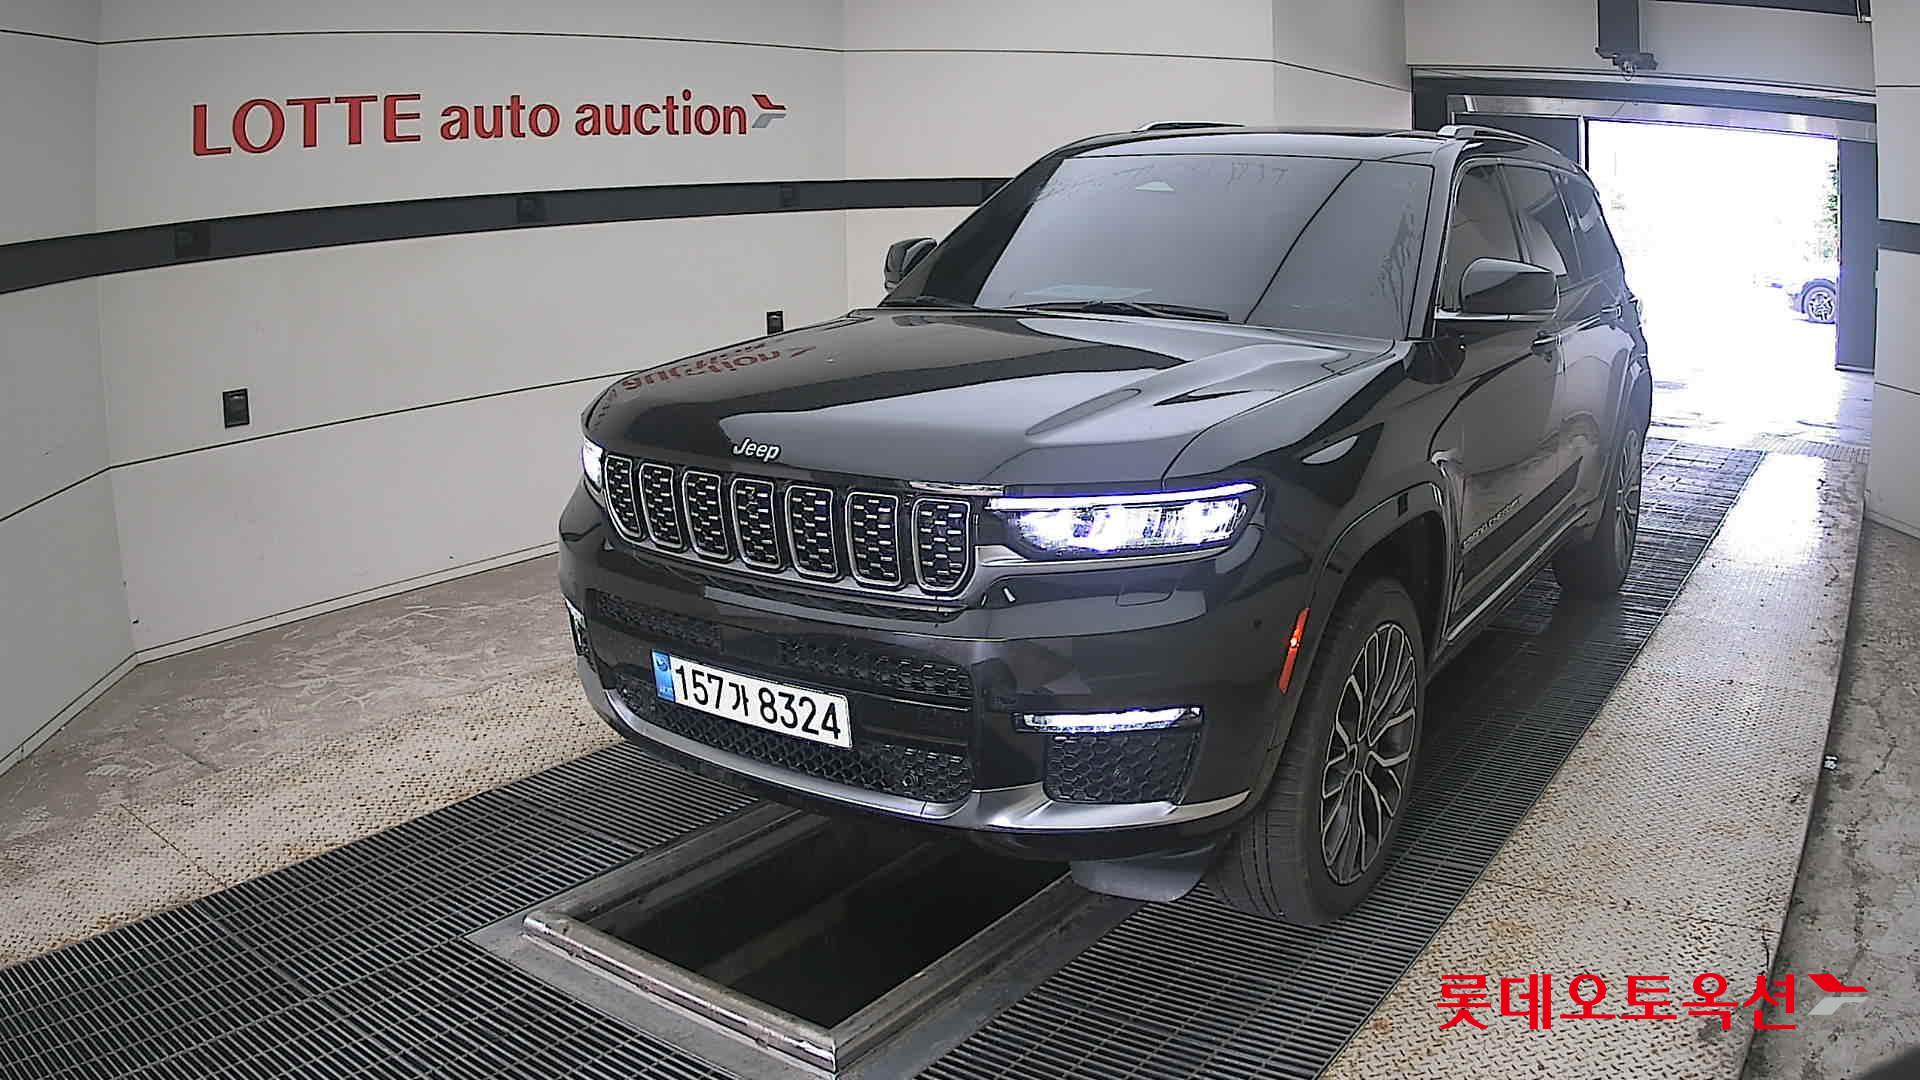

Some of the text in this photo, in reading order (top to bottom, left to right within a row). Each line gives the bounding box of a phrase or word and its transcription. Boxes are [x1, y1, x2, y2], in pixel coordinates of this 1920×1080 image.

[192, 89, 748, 156] LOTTE auto auction
[732, 437, 781, 463] Jeep
[675, 664, 841, 740] 157가 8324
